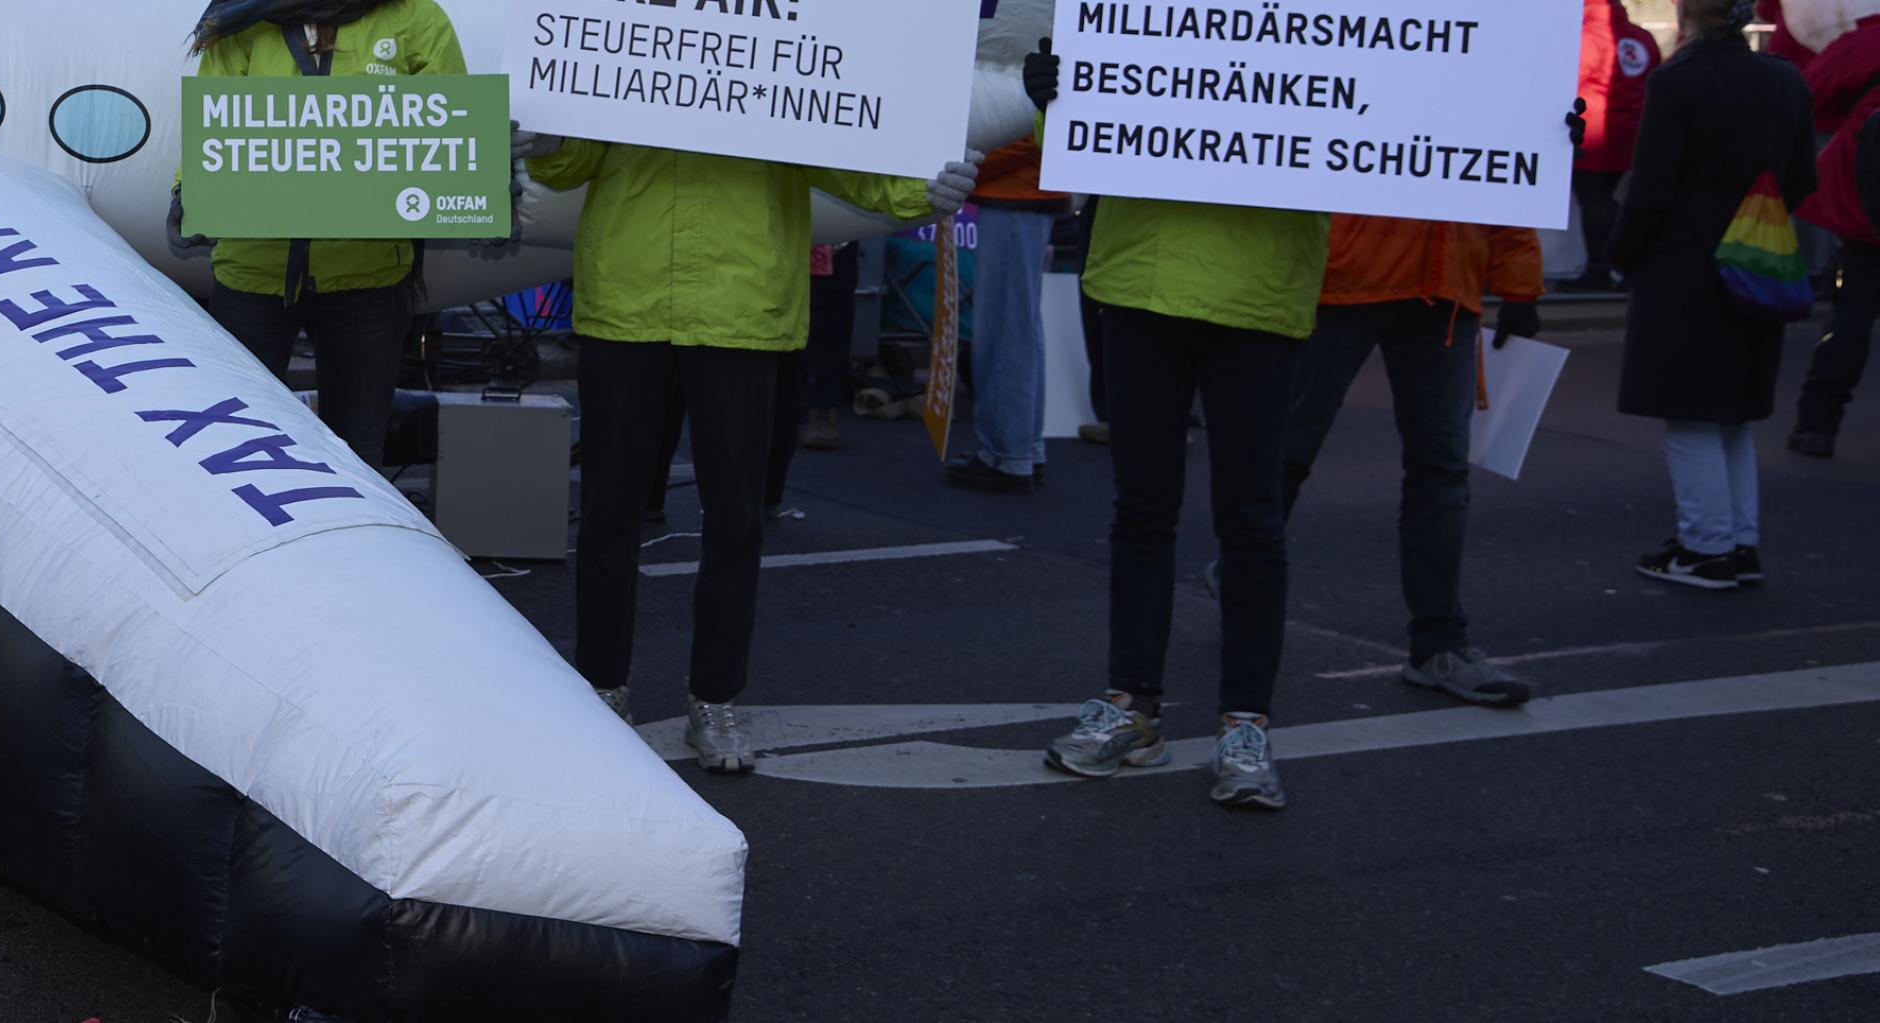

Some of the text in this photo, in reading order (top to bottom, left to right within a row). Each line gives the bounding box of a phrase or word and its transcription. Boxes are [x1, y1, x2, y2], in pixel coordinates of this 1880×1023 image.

[534, 13, 843, 79] STEUERFREI FÜR
[1078, 2, 1479, 54] MILLIARDÄRSMACHT
[202, 85, 469, 128] MILLIARDÄRS-
[1072, 61, 1370, 116] BESCHRÄNKEN,
[201, 137, 477, 172] STEUER JETZT!
[1066, 120, 1540, 186] DEMOKRATIE SCHÜTZEN
[436, 195, 487, 211] OXFAM
[436, 213, 494, 224] Deutschland
[133, 397, 365, 527] TAX
